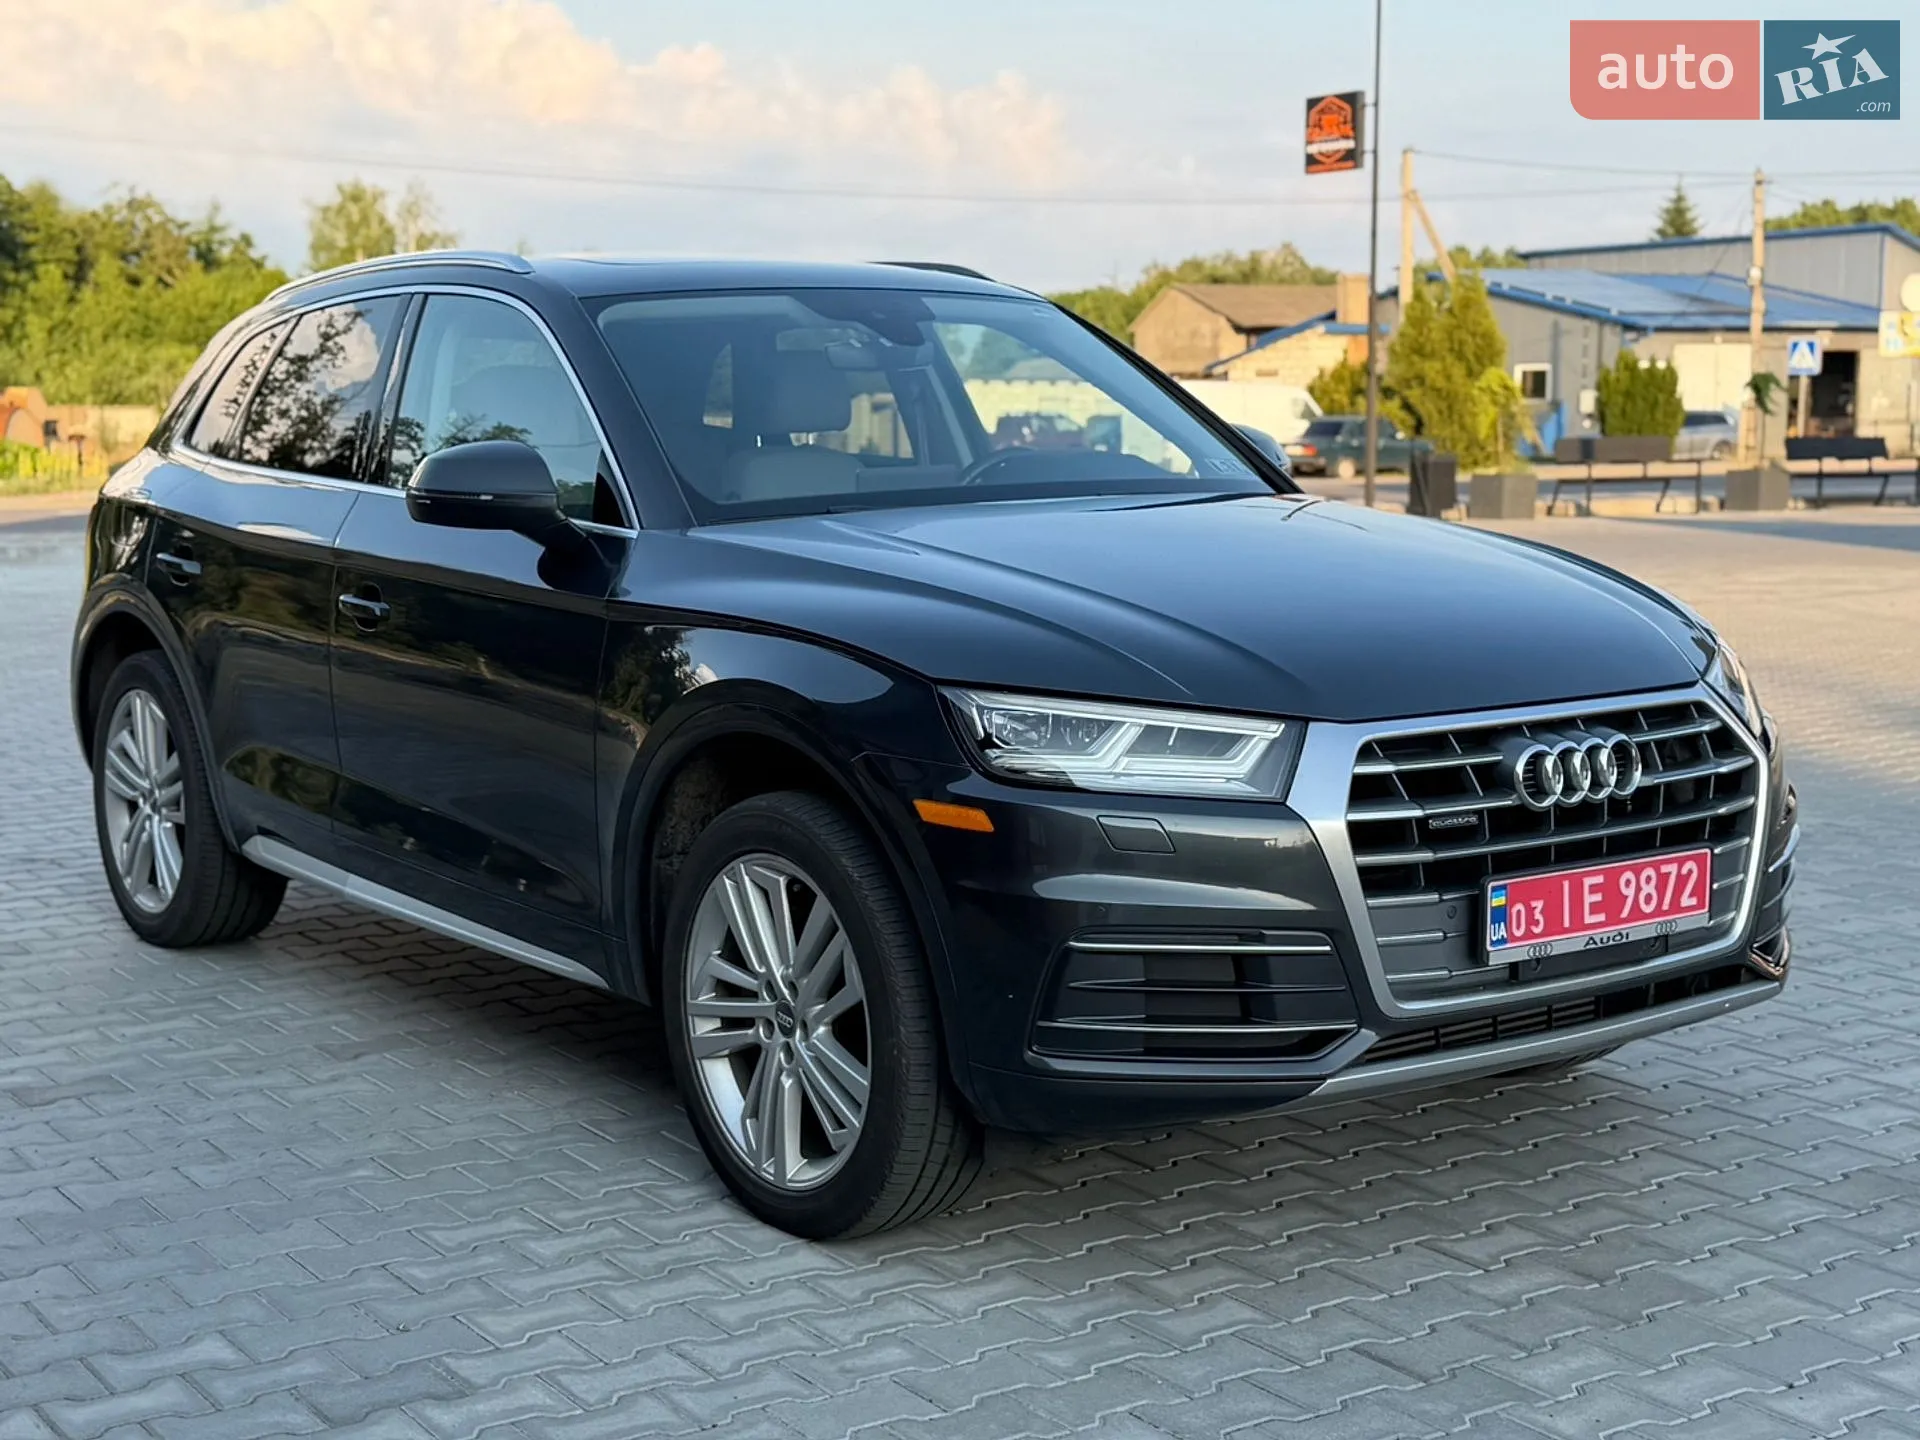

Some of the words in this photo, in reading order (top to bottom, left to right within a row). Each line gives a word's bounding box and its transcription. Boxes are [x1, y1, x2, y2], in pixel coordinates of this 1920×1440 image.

[1511, 900, 1544, 937] 03
[1562, 875, 1606, 928] IE
[1619, 860, 1698, 918] 9872
[1491, 923, 1507, 941] UA
[1583, 932, 1630, 948] Audi
